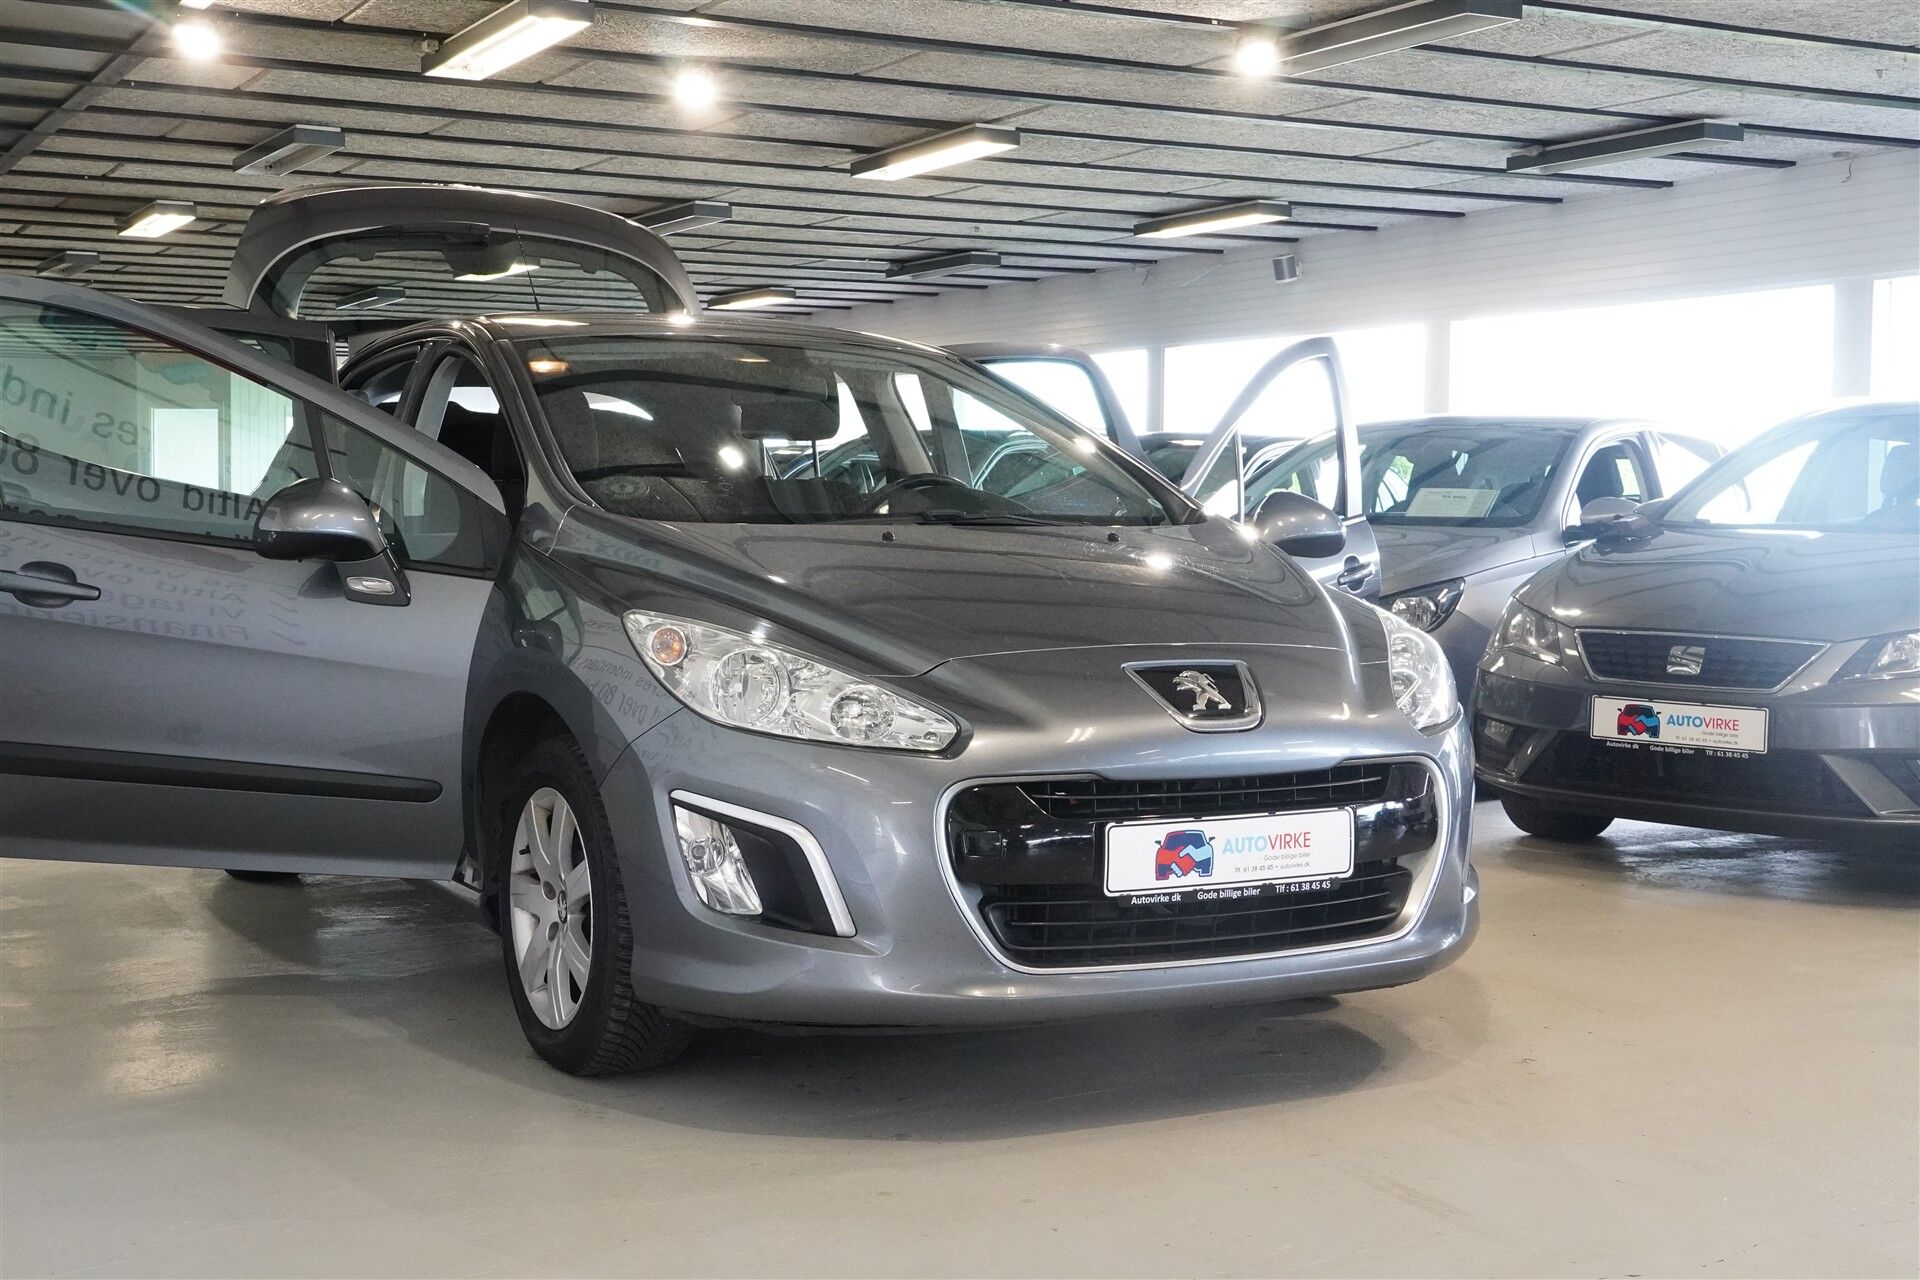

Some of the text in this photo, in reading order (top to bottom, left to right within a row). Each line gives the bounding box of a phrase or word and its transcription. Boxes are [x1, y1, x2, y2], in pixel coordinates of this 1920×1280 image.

[1667, 714, 1740, 731] AUTOVIRKE
[1222, 831, 1311, 855] AUTOVIRKE
[1131, 895, 1169, 905] Autovirke
[1171, 893, 1182, 902] dk
[1197, 891, 1218, 900] Gode
[1219, 889, 1242, 899] billige
[1243, 887, 1261, 896] biler
[1290, 883, 1300, 892] 61
[1301, 882, 1310, 891] 38
[1311, 881, 1321, 890] 45
[1321, 880, 1331, 889] 45
